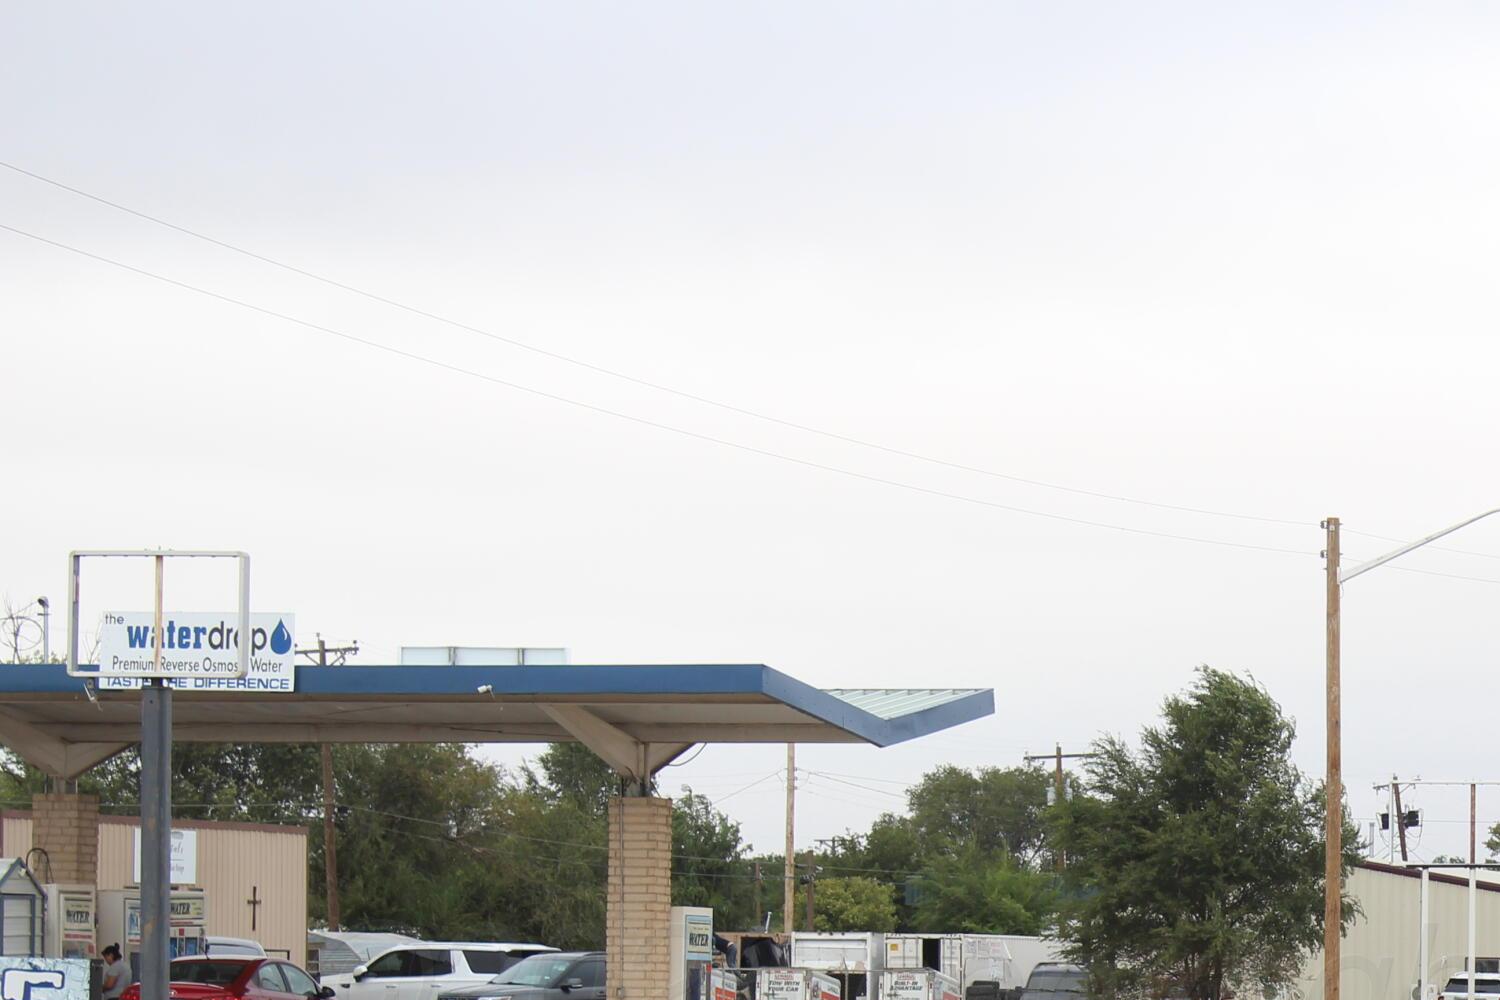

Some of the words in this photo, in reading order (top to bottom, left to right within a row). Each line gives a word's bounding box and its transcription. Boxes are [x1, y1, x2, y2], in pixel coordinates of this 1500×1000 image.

[105, 614, 125, 625] the
[202, 656, 239, 672] Osmos
[249, 657, 283, 673] Water
[194, 678, 290, 690] DIFFERENCE
